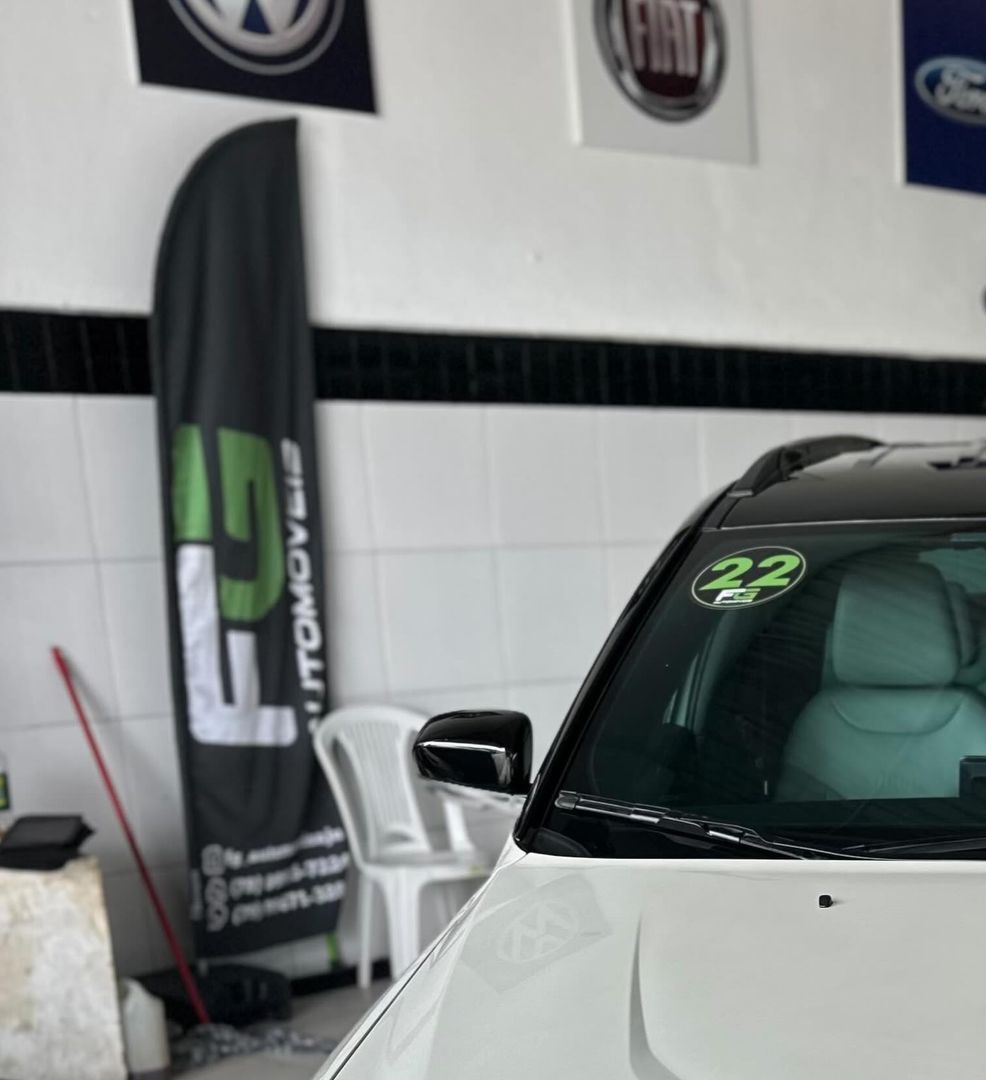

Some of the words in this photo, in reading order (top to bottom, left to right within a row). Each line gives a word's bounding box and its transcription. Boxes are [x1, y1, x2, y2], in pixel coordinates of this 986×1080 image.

[626, 0, 699, 76] FIAT
[699, 554, 800, 590] 22
[715, 588, 761, 602] FG
